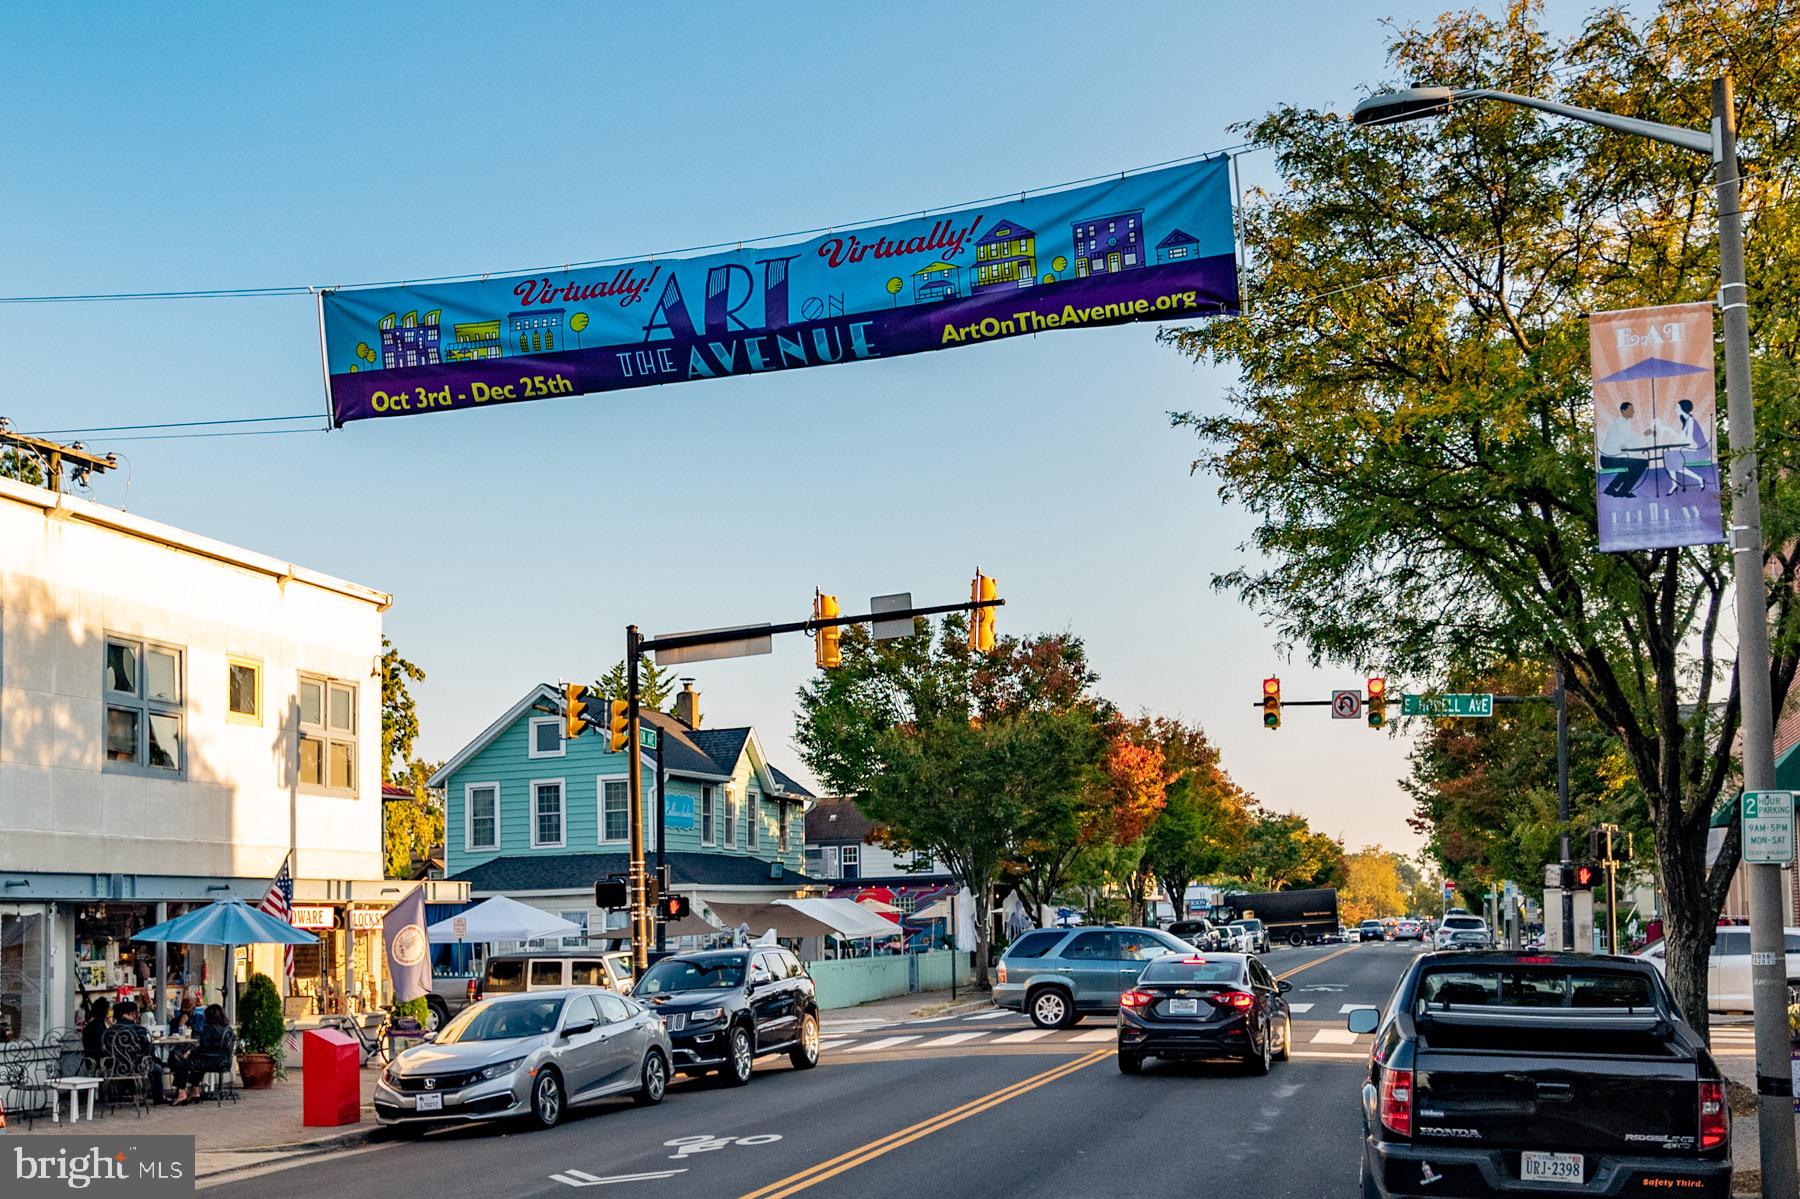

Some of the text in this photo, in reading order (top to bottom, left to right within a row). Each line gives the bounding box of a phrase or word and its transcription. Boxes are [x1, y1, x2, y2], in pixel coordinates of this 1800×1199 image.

[818, 214, 983, 268] Virtually!
[513, 265, 661, 307] Virtually!
[642, 254, 802, 342] ART
[801, 291, 845, 321] ON
[941, 291, 1197, 344] ArtOnTheAvenue.org
[1616, 322, 1686, 348] EAT
[616, 320, 881, 379] THE AVENUE
[371, 391, 410, 412] Oct
[415, 385, 452, 408] 3rd
[471, 382, 517, 402] Dec
[519, 374, 573, 397] 25th
[1404, 699, 1411, 712] E
[1469, 698, 1488, 712] AVE
[1745, 798, 1756, 814] 2
[1758, 797, 1781, 805] HOUR
[1758, 806, 1790, 814] PARKING
[1748, 823, 1788, 832] 9AM-5PM
[1750, 836, 1785, 844] MON-SAT
[1419, 1127, 1482, 1138] HONDA
[1625, 1133, 1695, 1143] RIDGELINE
[1526, 1160, 1580, 1176] URJ-2398
[1643, 1178, 1704, 1189] Safety Third.
